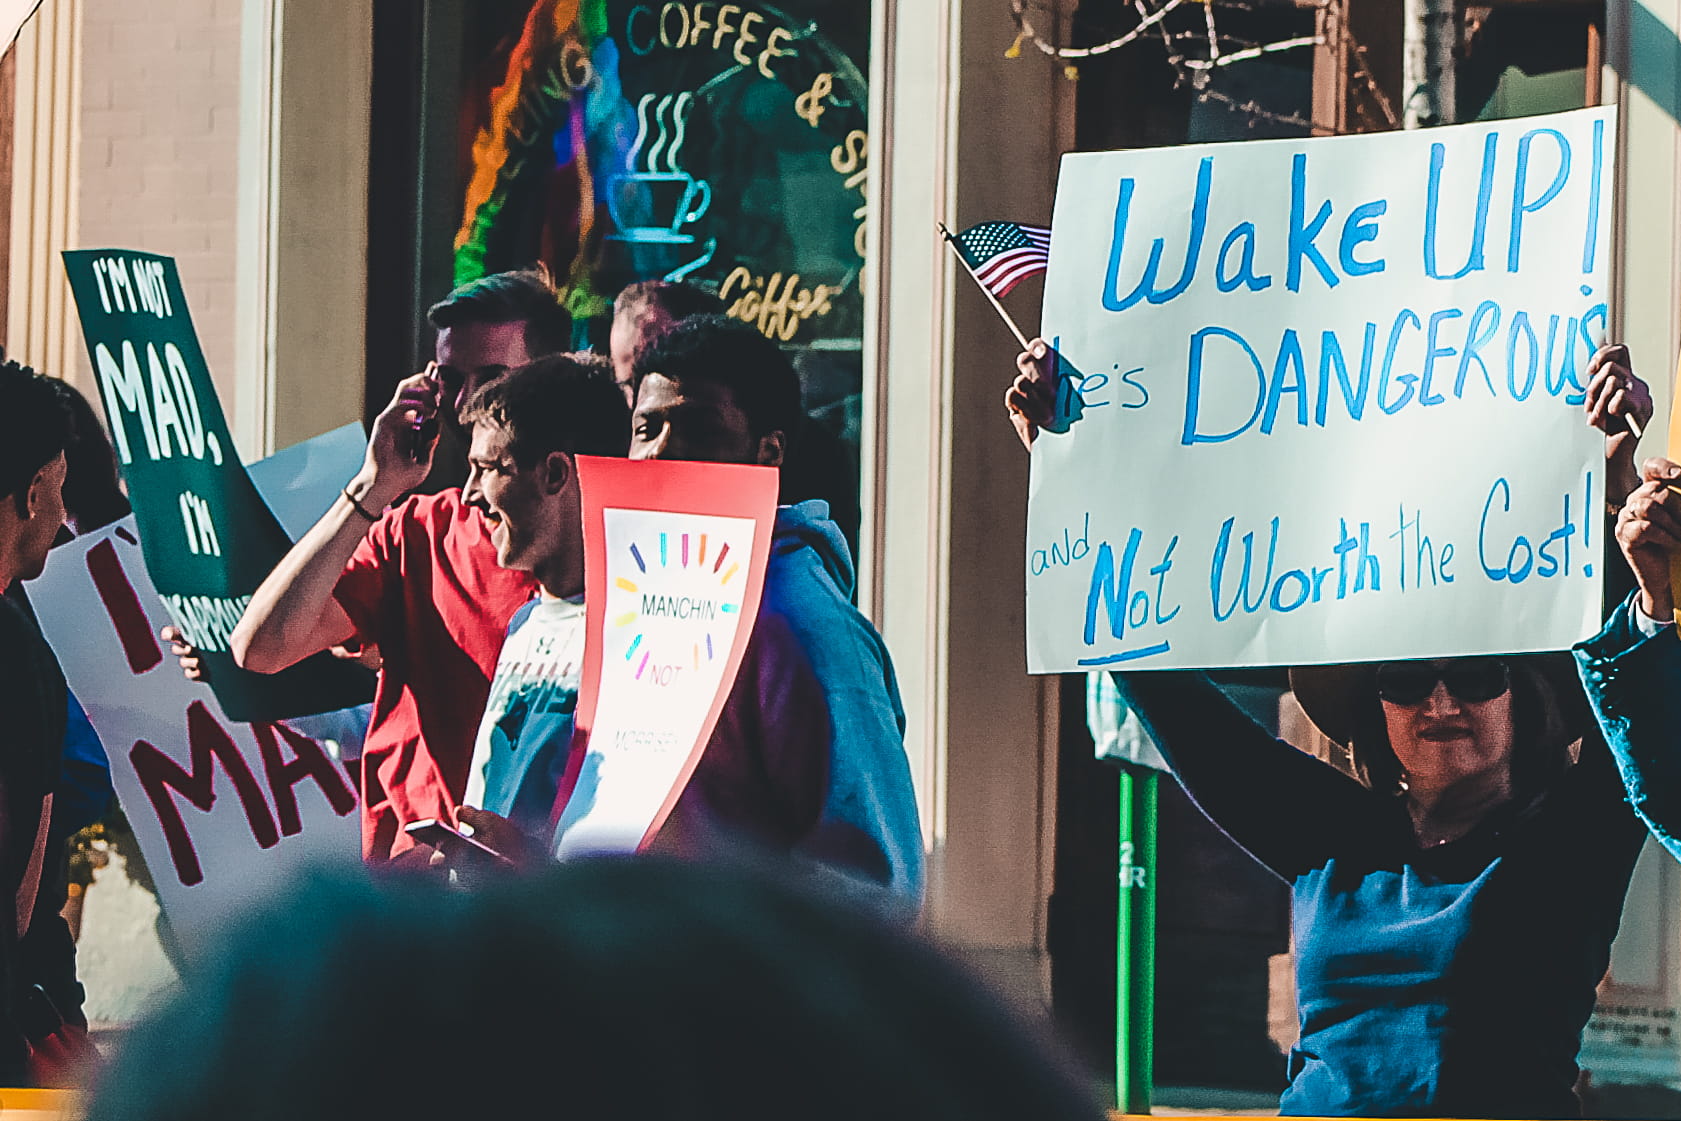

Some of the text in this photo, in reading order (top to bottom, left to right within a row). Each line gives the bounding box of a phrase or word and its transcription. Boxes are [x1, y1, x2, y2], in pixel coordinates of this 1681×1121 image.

[625, 1, 834, 128] COFFEE &
[1102, 119, 1605, 313] Wake UP!
[93, 256, 173, 319] I'M NOT
[96, 340, 223, 467] MAD,
[1181, 298, 1608, 447] DANGEROUS
[179, 490, 221, 557] I'M
[1083, 527, 1183, 646] Not
[1210, 515, 1382, 623] Worth
[1390, 504, 1456, 594] the
[1477, 471, 1594, 585] Cost!
[641, 593, 718, 621] MANCHIN
[649, 664, 684, 687] NOT
[129, 699, 361, 887] MA
